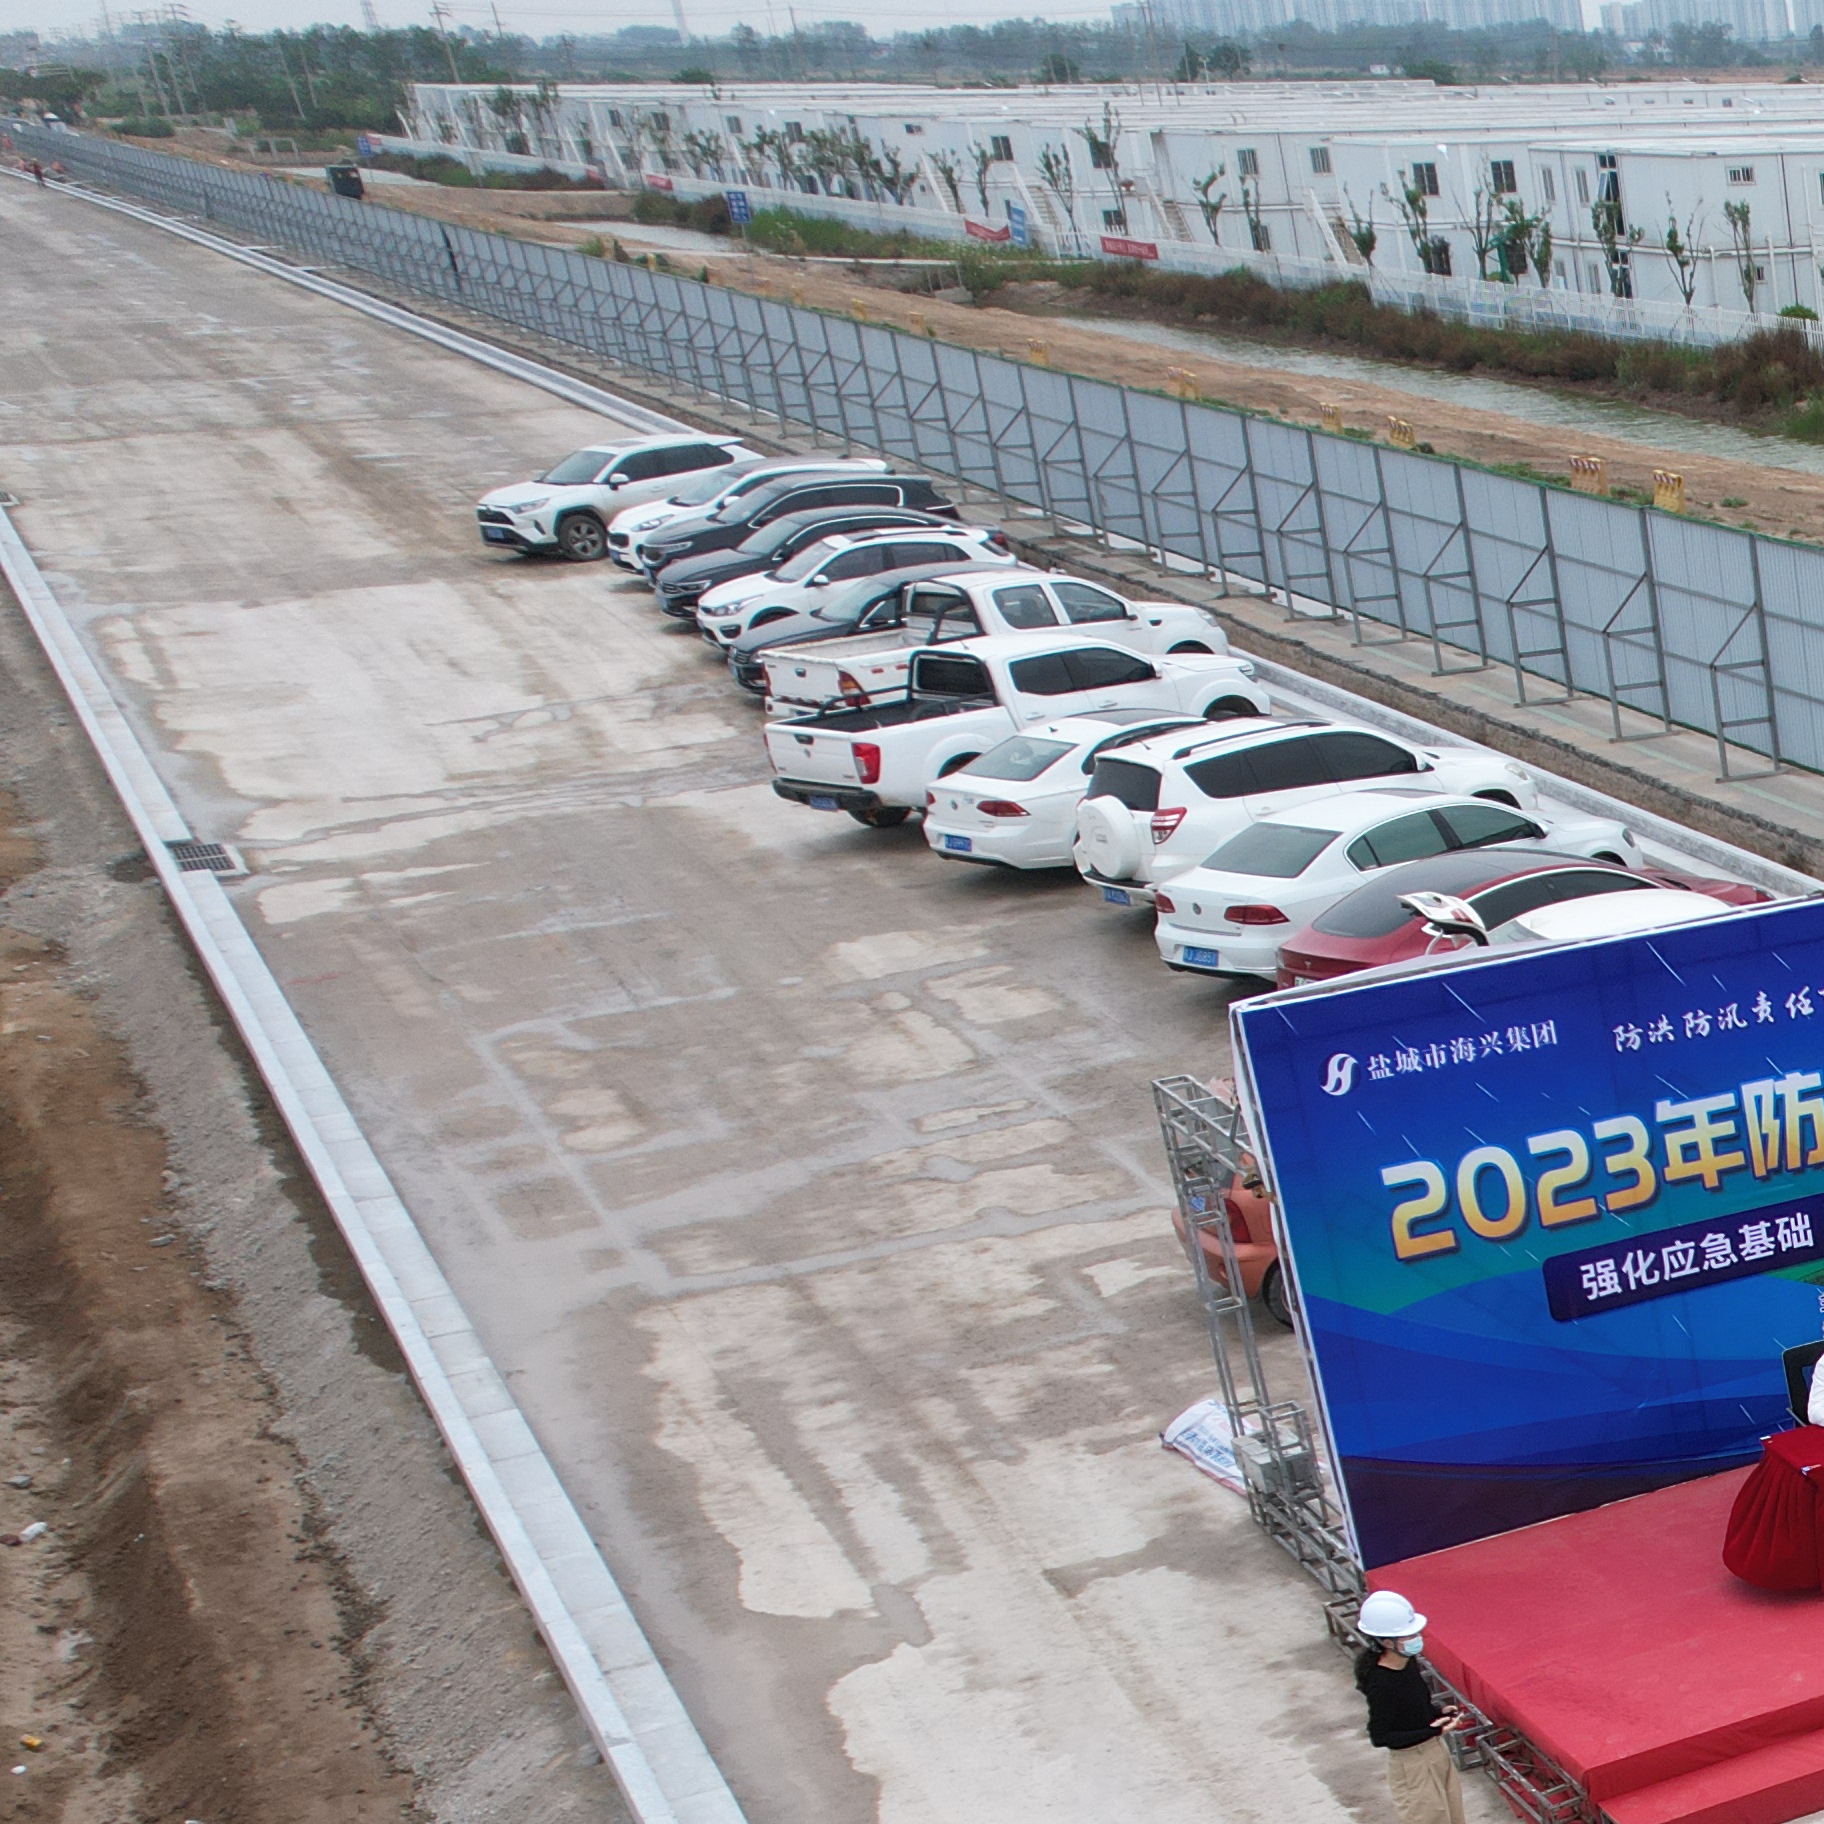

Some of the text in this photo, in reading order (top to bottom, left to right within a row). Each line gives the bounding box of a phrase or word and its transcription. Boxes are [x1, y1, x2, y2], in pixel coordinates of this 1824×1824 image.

[1366, 1018, 1560, 1083] 盐城市海兴集团
[1578, 1212, 1815, 1304] 强化应急基础
